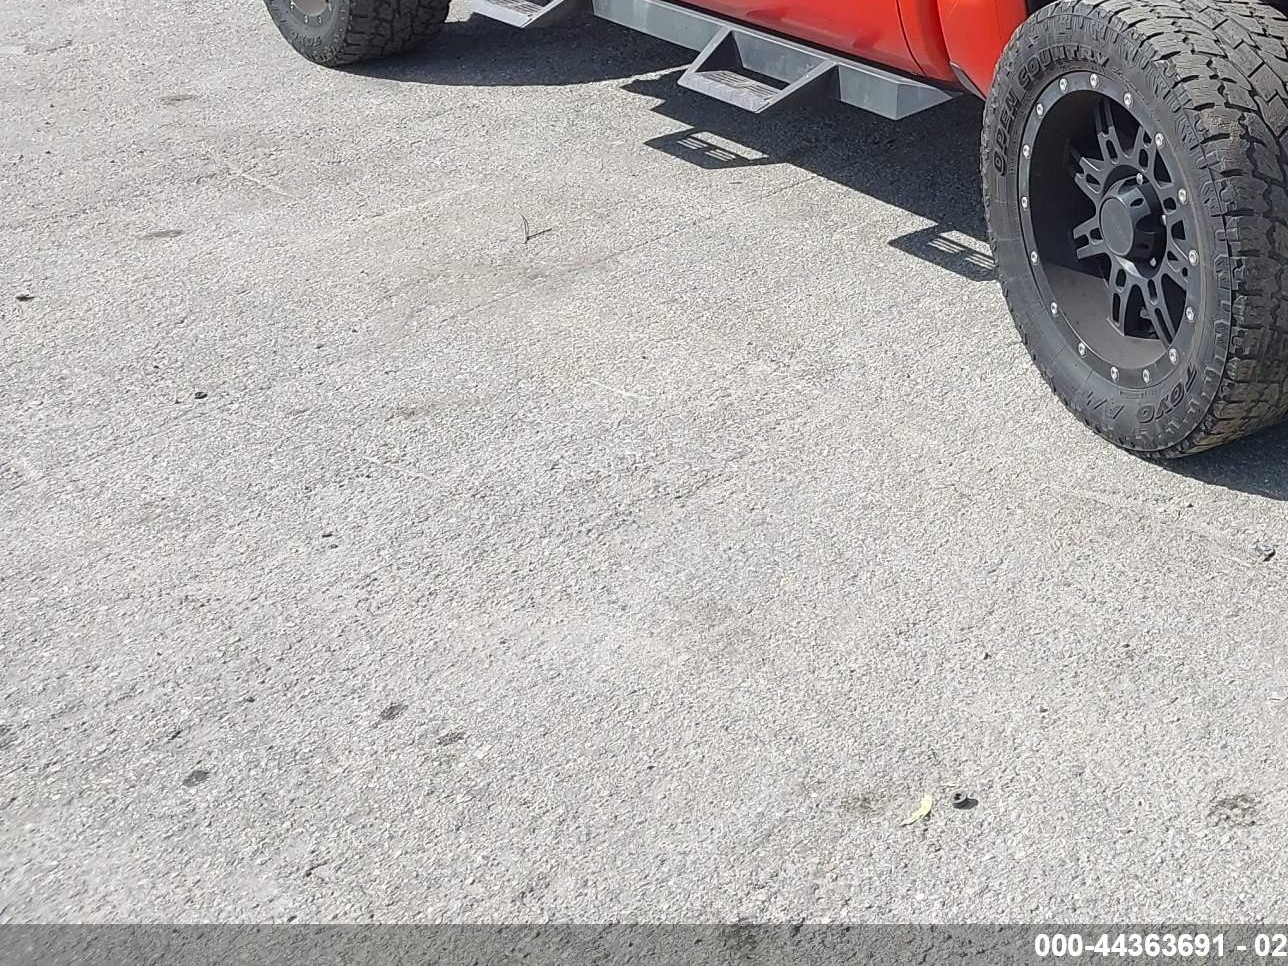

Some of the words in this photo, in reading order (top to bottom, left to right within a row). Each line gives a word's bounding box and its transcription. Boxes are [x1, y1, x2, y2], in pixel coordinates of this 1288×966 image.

[994, 87, 1021, 176] OPEN
[1017, 44, 1110, 91] COUNTRY
[1136, 362, 1198, 424] TOYO
